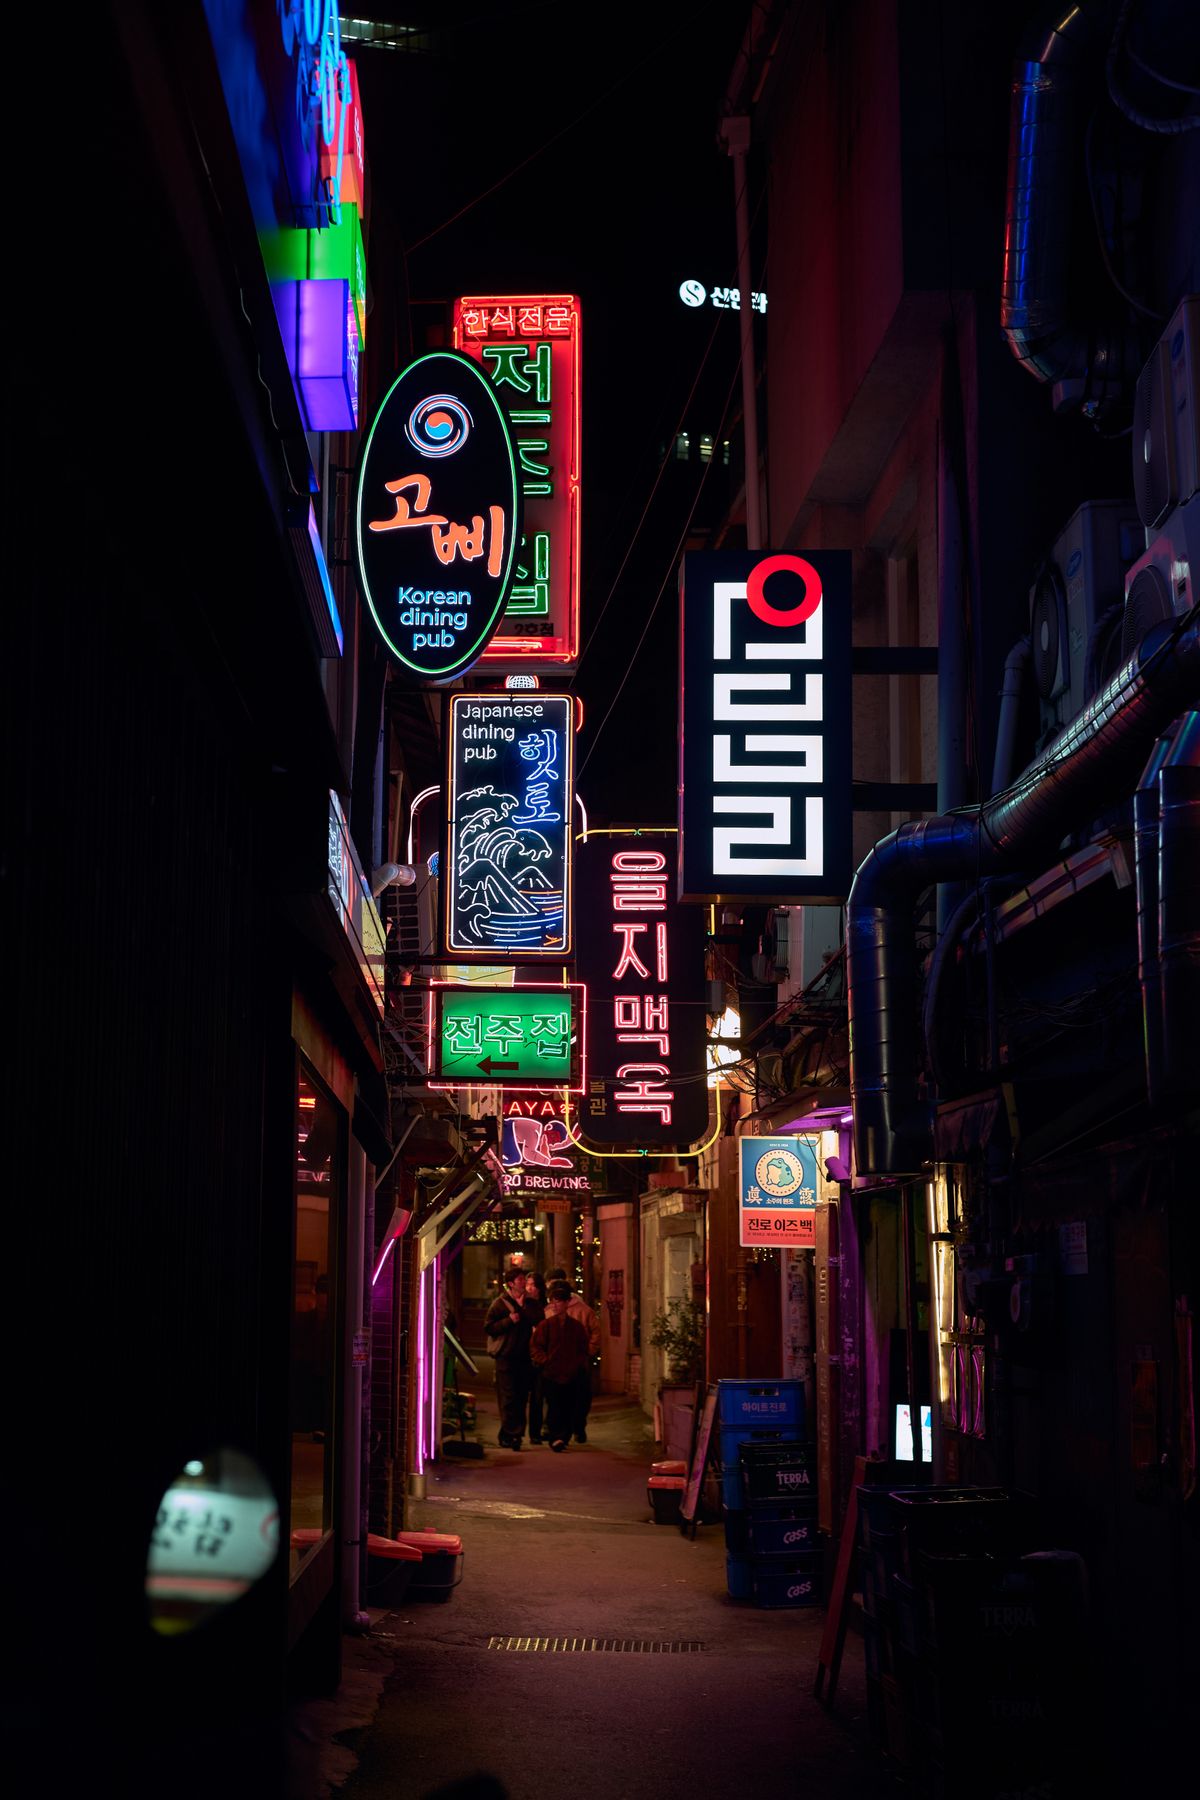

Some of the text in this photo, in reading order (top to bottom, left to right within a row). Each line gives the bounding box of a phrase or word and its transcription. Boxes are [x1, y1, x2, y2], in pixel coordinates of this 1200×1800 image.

[462, 304, 572, 334] 한식전문
[368, 473, 506, 578] 고삐
[398, 586, 472, 606] Korean
[399, 607, 469, 630] dining
[412, 629, 456, 651] pub
[461, 704, 544, 721] Japanese
[462, 724, 515, 741] dining
[463, 745, 497, 763] pub
[609, 850, 675, 1126] 을지맥옥
[444, 1012, 568, 1059] 전주집
[502, 1100, 556, 1116] AYA
[524, 1175, 592, 1190] BREWING
[747, 1218, 813, 1232] 진로 이즈 백
[741, 1401, 788, 1413] 하이트진로
[775, 1470, 811, 1485] TERRA
